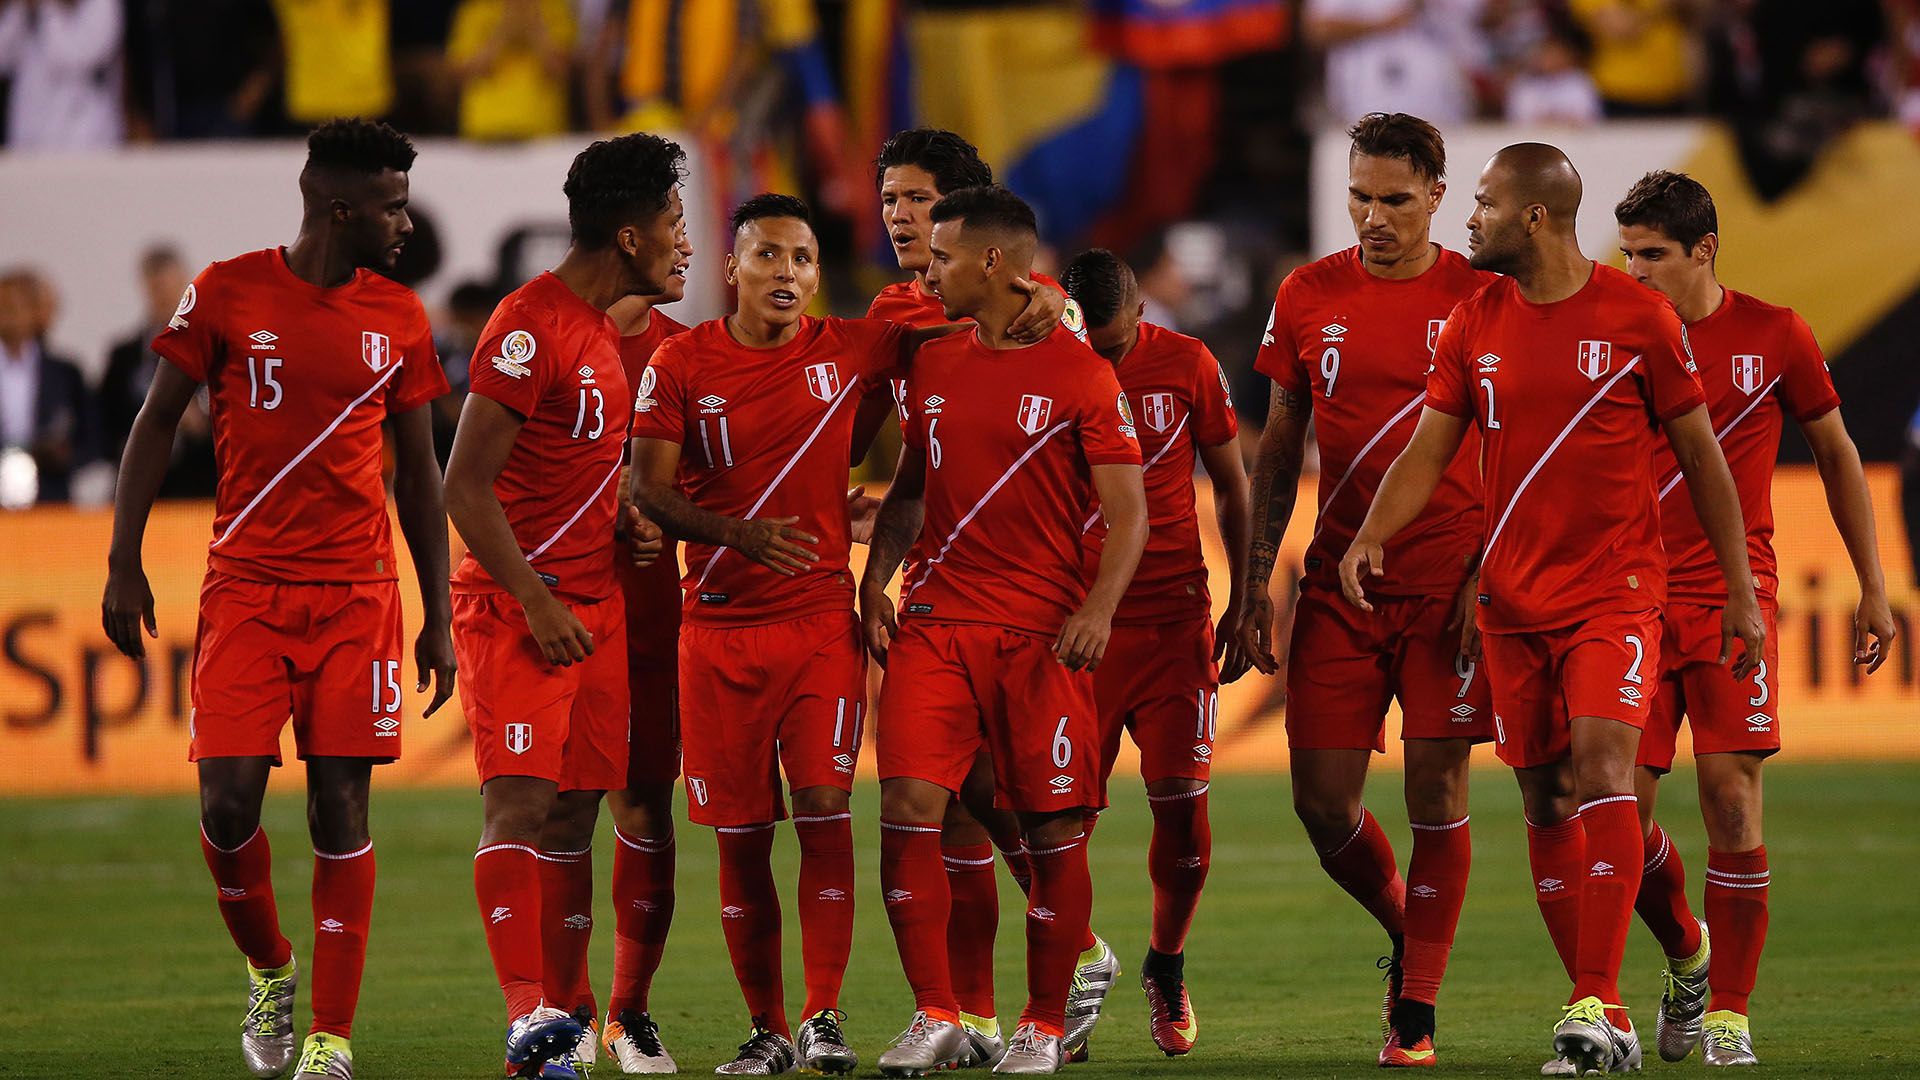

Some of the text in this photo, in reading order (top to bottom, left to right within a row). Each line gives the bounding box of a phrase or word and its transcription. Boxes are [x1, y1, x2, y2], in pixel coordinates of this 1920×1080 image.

[251, 343, 276, 351] umbro
[1321, 346, 1341, 398] 9
[247, 356, 284, 410] 15
[572, 387, 605, 440] 13
[699, 416, 734, 470] 11
[928, 417, 943, 470] 6
[1622, 634, 1645, 686] 2
[1749, 658, 1769, 708] 3
[371, 660, 402, 714] 15
[1620, 696, 1640, 708] umbro
[832, 697, 861, 752] 11
[1196, 687, 1219, 743] 10
[1051, 716, 1073, 769] 6
[1052, 787, 1072, 795] umbro
